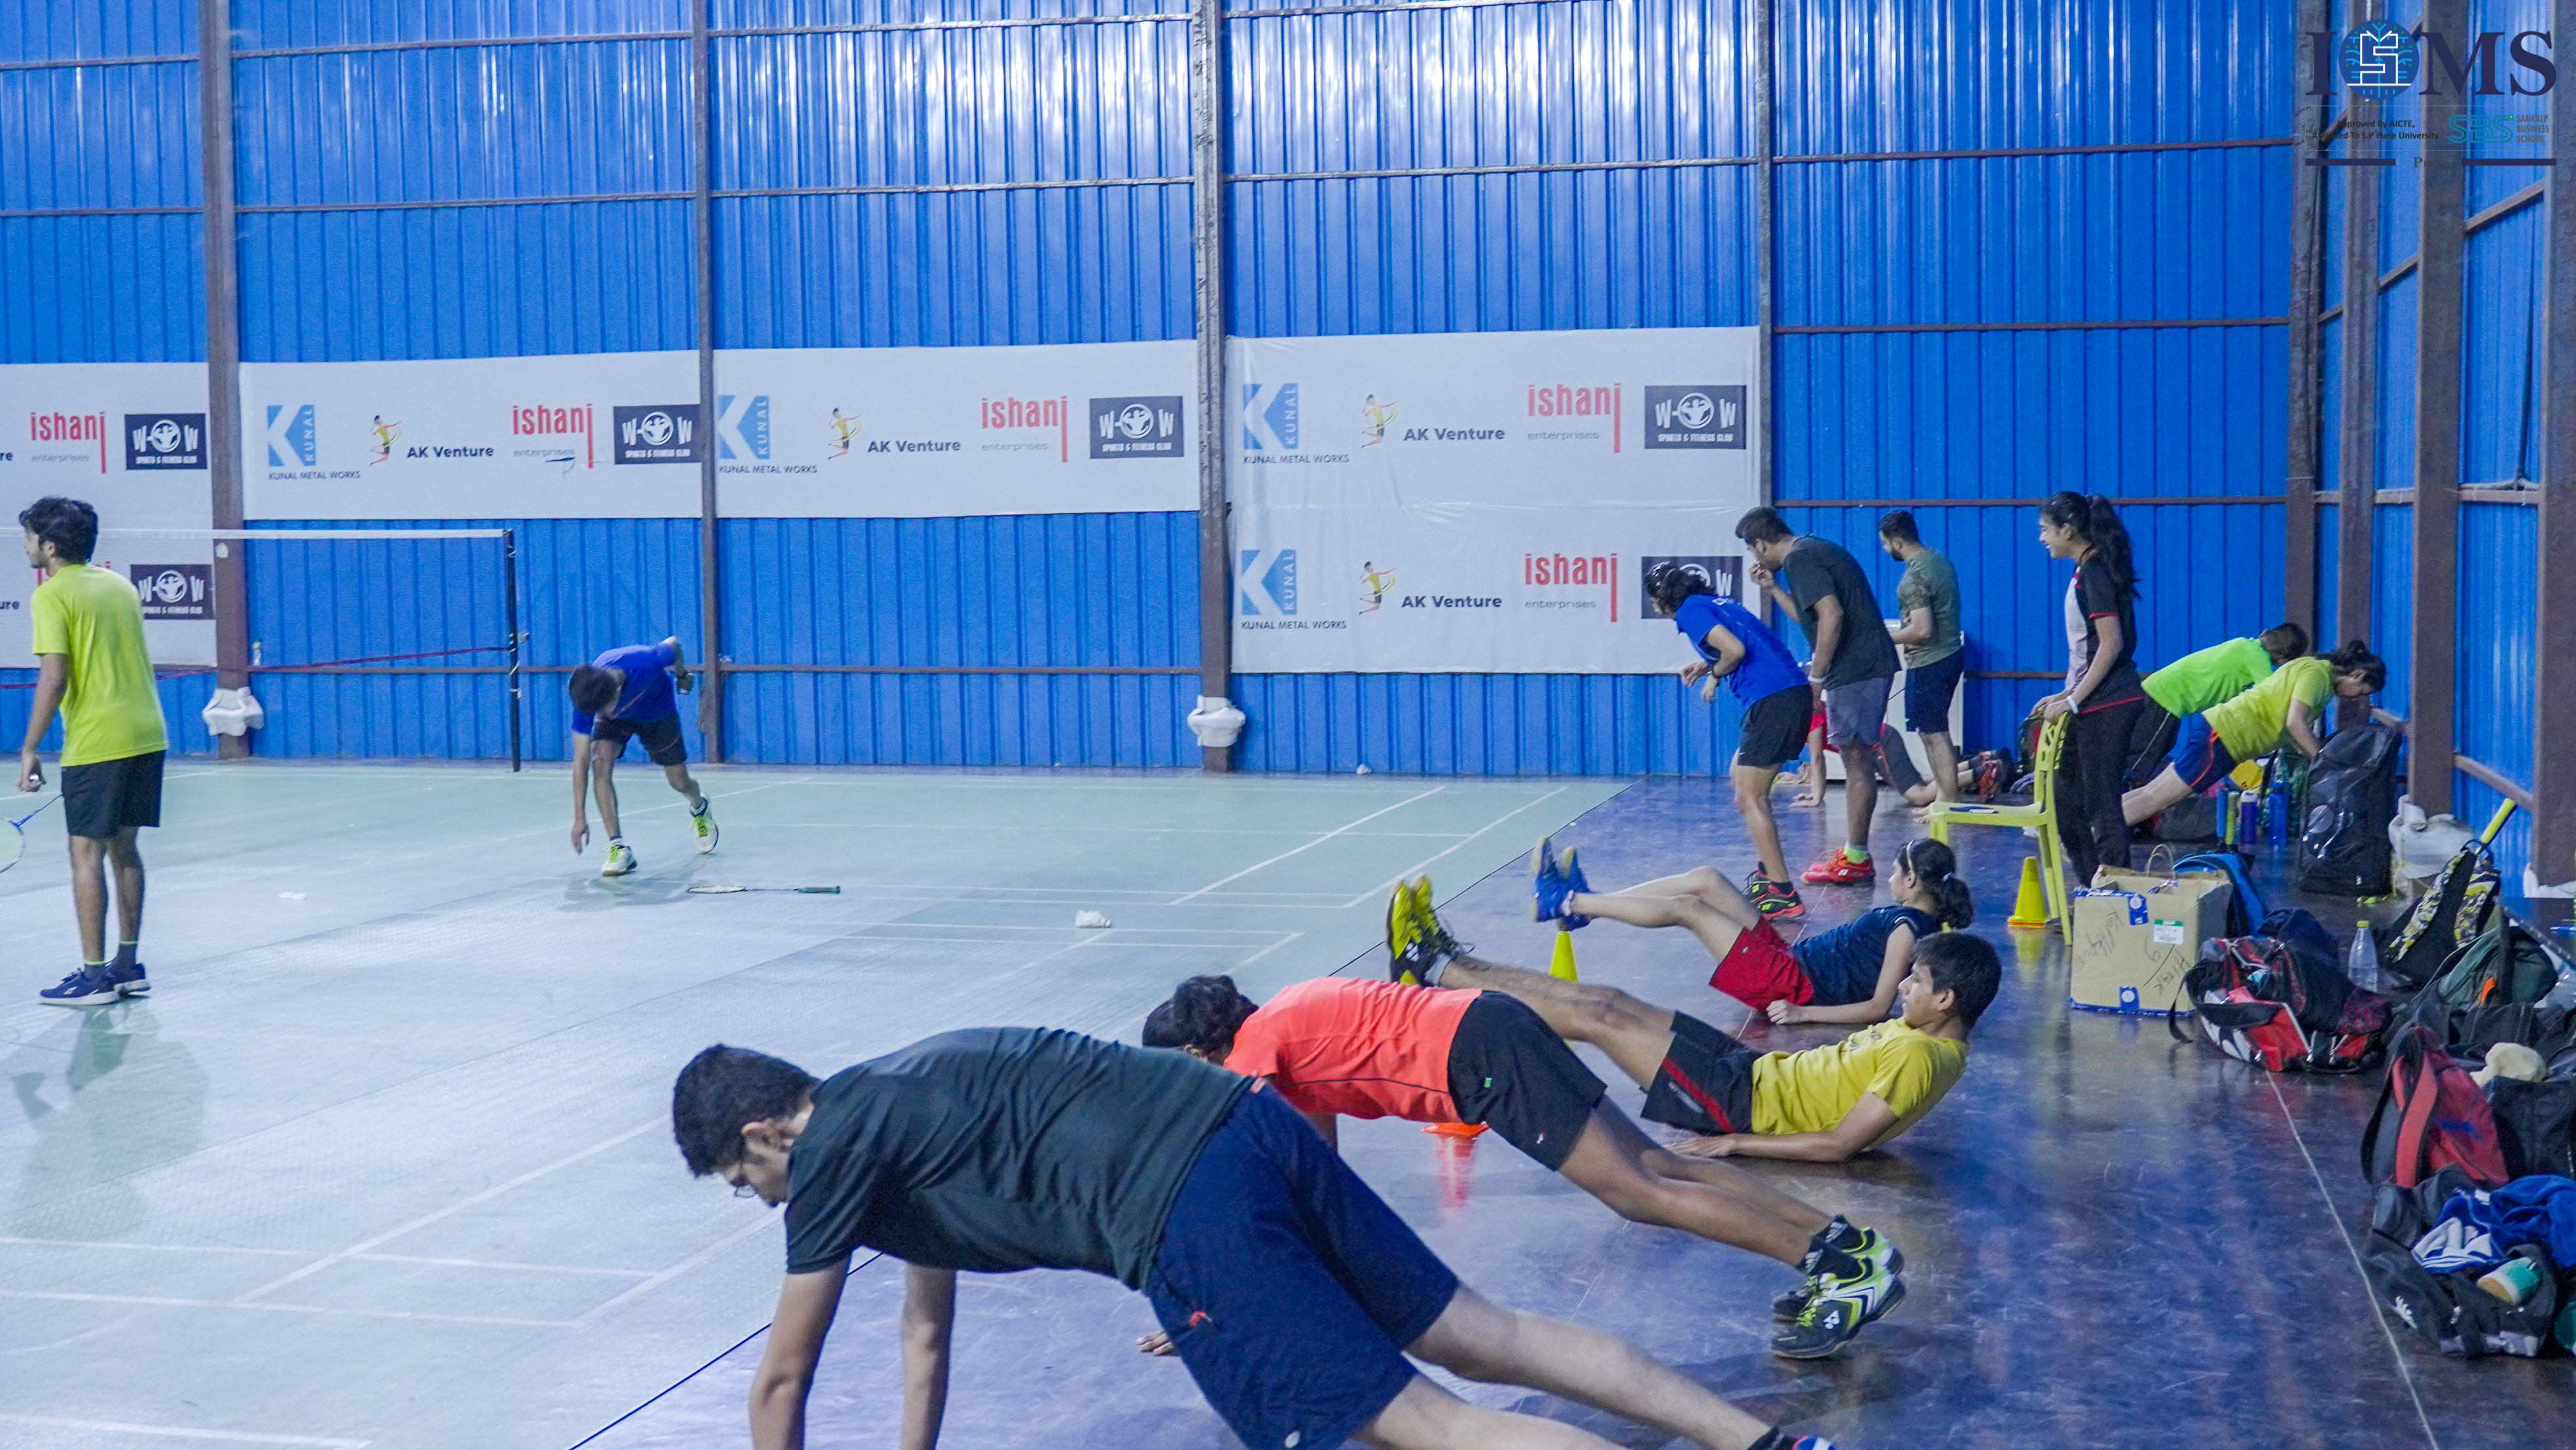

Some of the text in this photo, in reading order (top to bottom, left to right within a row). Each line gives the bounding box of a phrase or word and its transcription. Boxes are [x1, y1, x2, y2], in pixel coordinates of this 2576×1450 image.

[1285, 387, 1296, 445] KUNAL
[757, 400, 768, 456] KUNAL
[303, 406, 314, 465] KUNAL
[1404, 428, 1505, 440] AK Venture
[1528, 431, 1599, 440] enterprises
[407, 445, 493, 459] AK Venture
[867, 440, 961, 453] AK Venture
[982, 443, 1048, 451] enterprises
[513, 448, 575, 457] enterprises
[1243, 455, 1276, 464] KUNAL
[1314, 455, 1349, 463] WORKS
[720, 465, 750, 474] KUNAL
[783, 465, 817, 473] WORKS
[268, 471, 296, 480] KUNAL
[300, 471, 327, 480] METAL
[1283, 554, 1295, 611] KUNAL
[1401, 595, 1502, 607] AK Venture
[1525, 599, 1596, 609] enterprises
[1242, 621, 1274, 629] KUNAL
